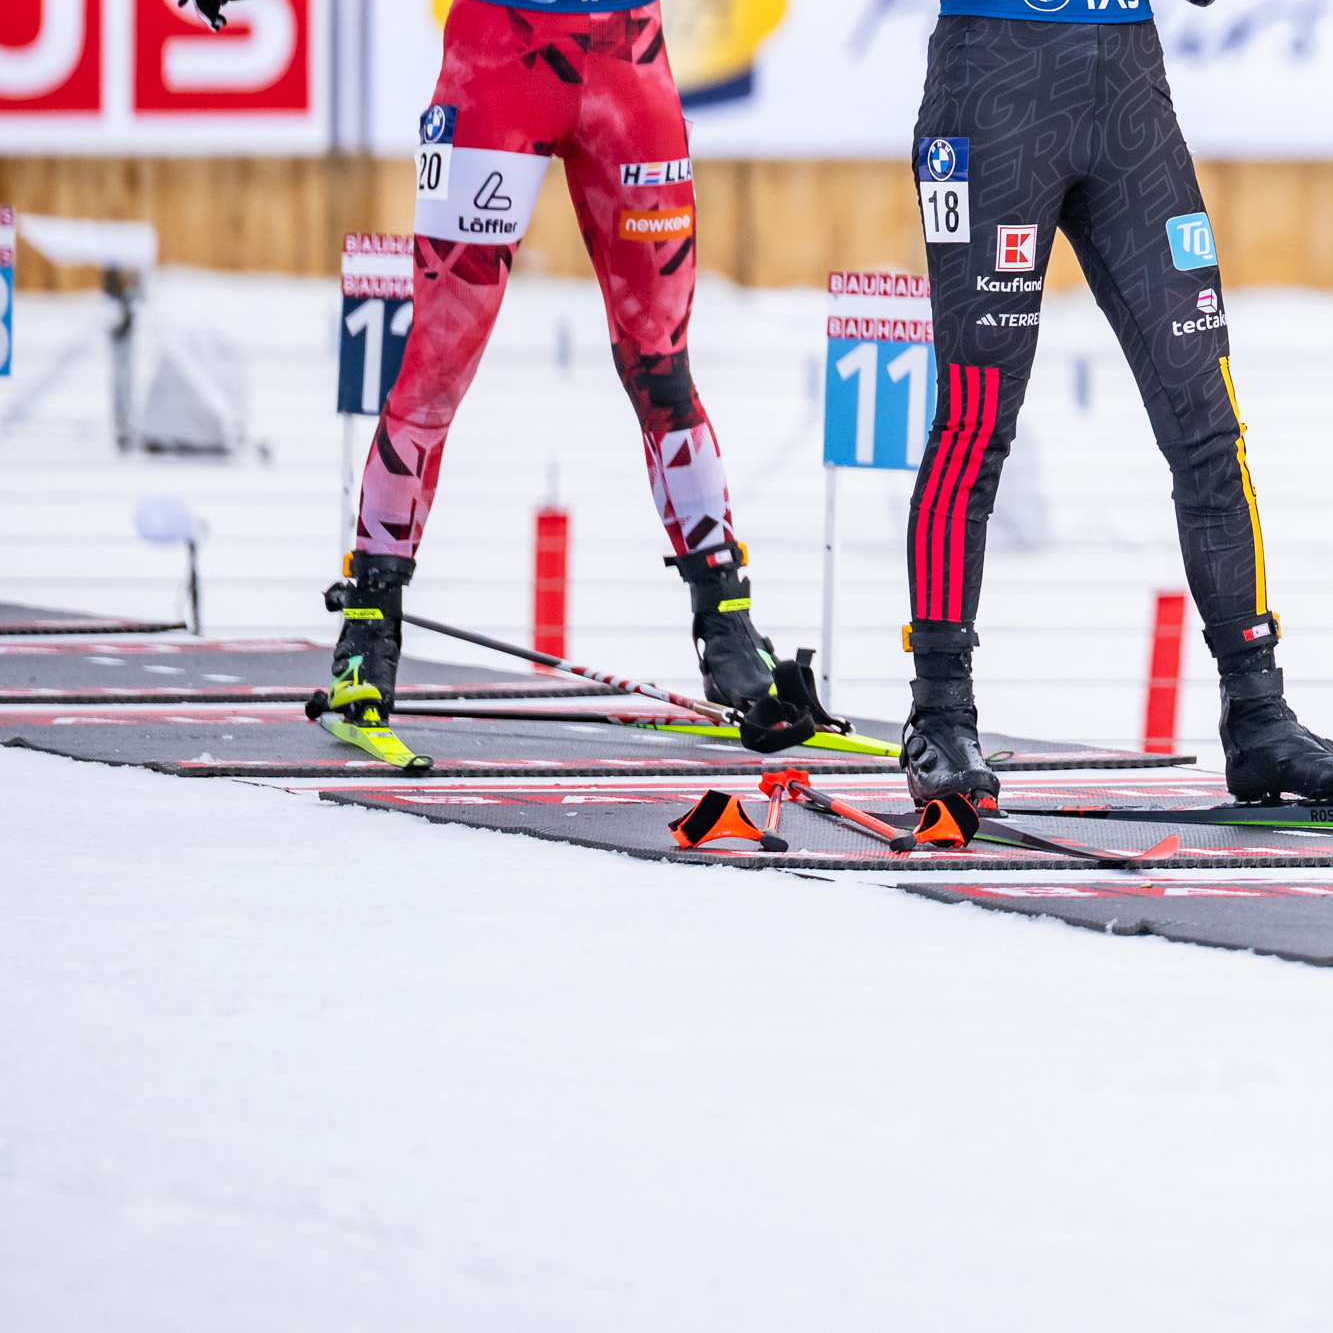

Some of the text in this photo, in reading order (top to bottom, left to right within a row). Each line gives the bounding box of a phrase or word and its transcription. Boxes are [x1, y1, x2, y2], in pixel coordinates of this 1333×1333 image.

[418, 151, 442, 191] 20
[458, 214, 518, 234] Löffler
[928, 189, 960, 233] 18
[1175, 220, 1215, 260] TQ
[830, 272, 931, 297] BAUHAU
[976, 275, 1043, 293] Kaufland
[828, 318, 933, 340] BAUHAUS
[835, 342, 928, 466] 11
